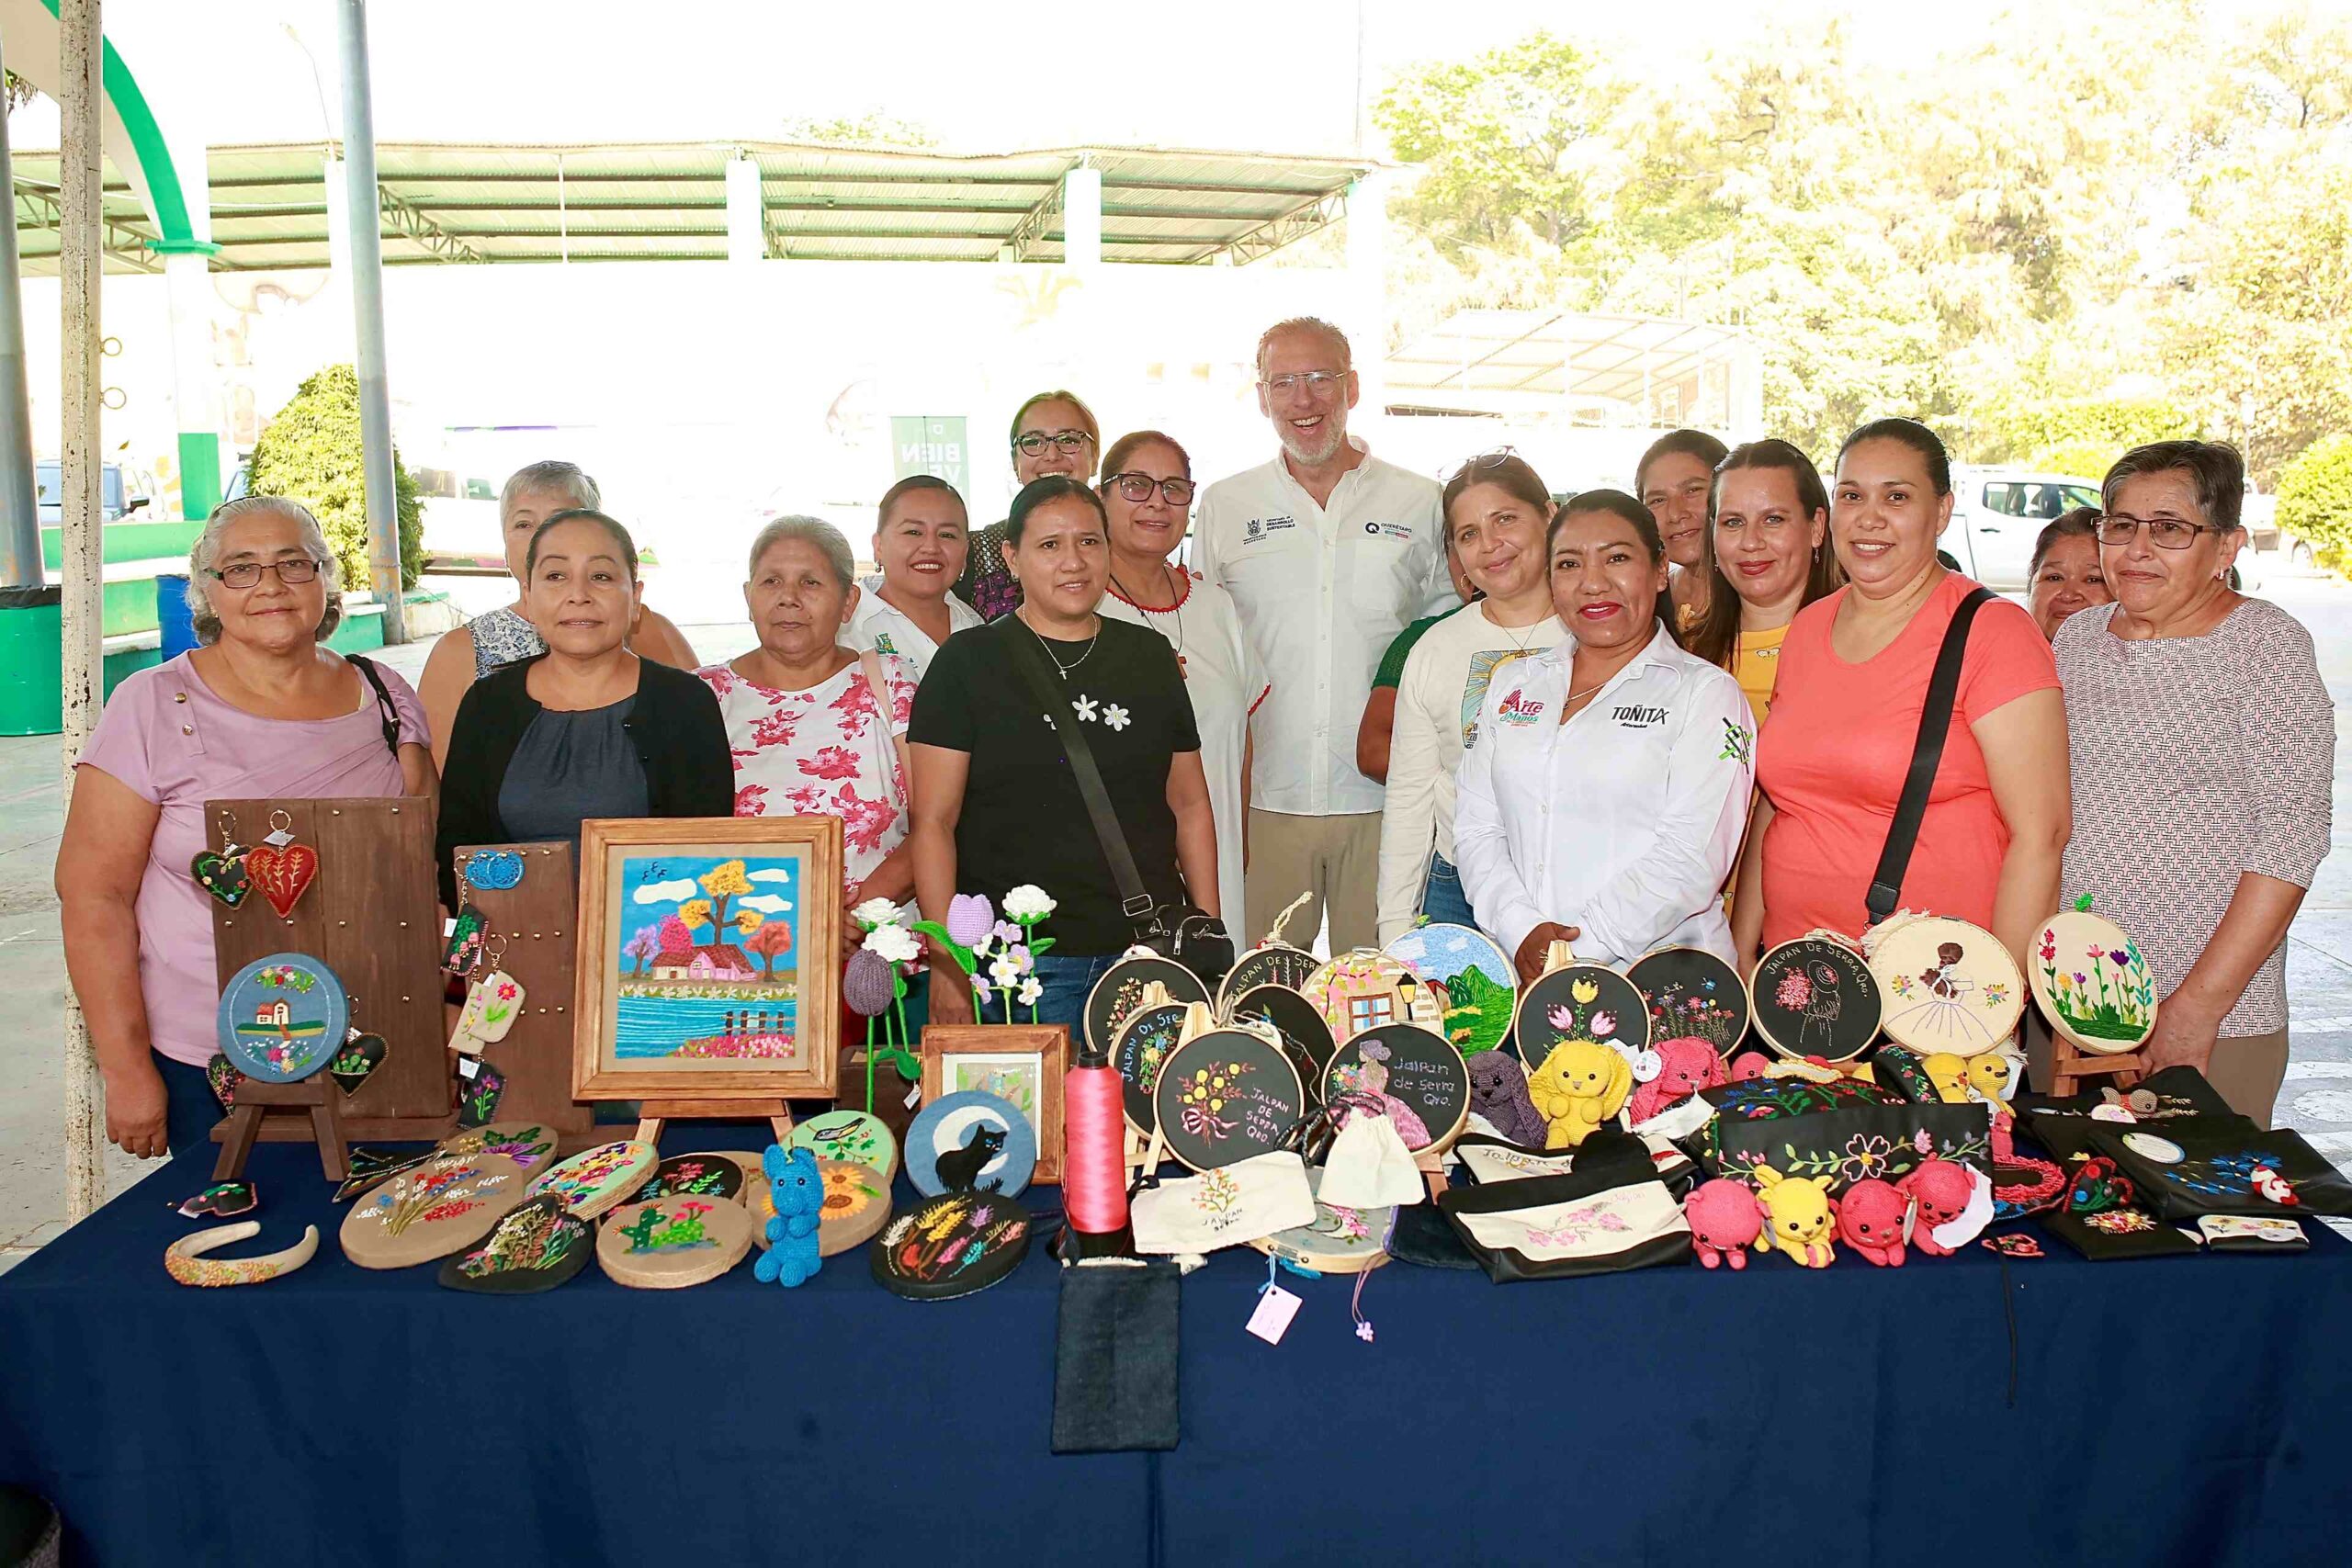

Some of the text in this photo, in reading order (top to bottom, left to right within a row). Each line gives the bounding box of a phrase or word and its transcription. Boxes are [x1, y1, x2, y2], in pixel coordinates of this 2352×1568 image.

[1507, 690, 1544, 713] Arte
[1611, 704, 1669, 725] TOÑITA
[1764, 946, 1802, 975] JALPAN
[1230, 963, 1262, 1000] JALPAN
[1266, 956, 1281, 965] DE
[1121, 1037, 1137, 1082] JALPAN
[1394, 1076, 1413, 1090] de
[1250, 1087, 1289, 1113] JALPAN
[1258, 1104, 1272, 1118] DE
